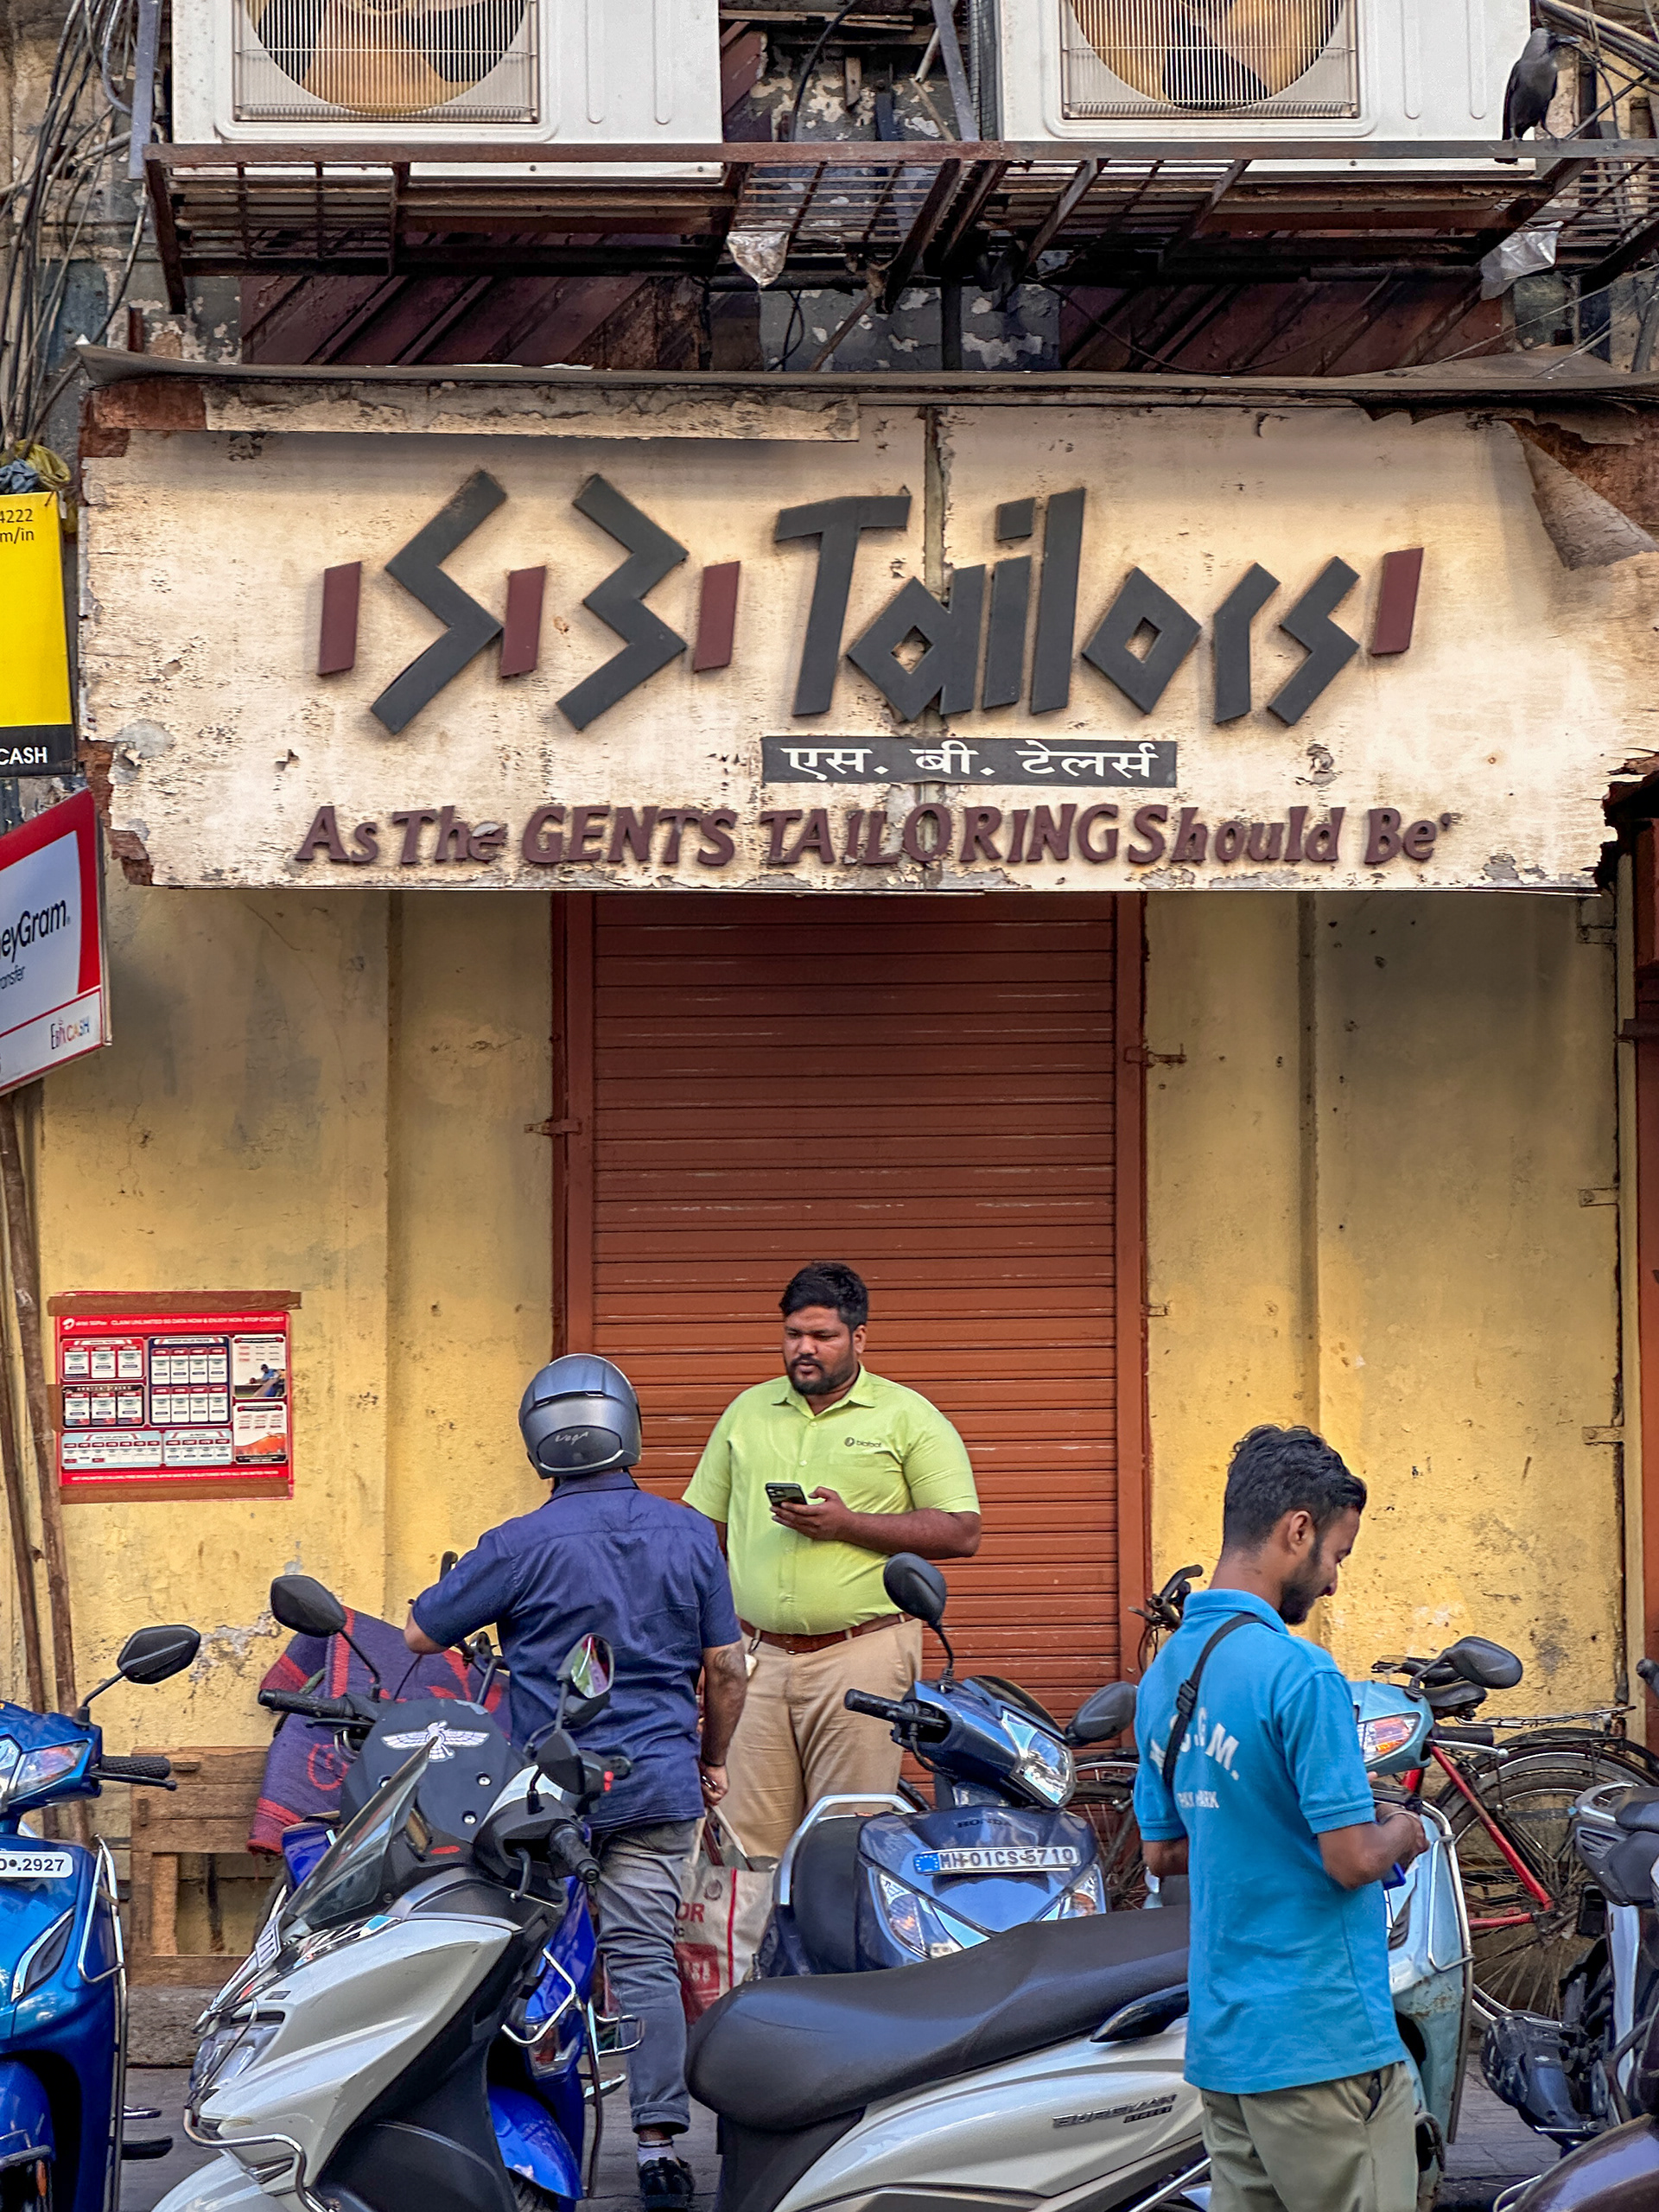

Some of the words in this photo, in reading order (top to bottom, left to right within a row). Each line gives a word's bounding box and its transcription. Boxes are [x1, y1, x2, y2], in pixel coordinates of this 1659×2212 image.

[0, 747, 48, 766] CASH
[780, 747, 890, 781] एस.
[910, 740, 995, 776] बी.
[1015, 739, 1159, 779] टेलर्स
[295, 805, 378, 863] As
[392, 804, 507, 863] The
[521, 804, 736, 864] GENTS
[759, 803, 1120, 865] TAILORING
[1128, 804, 1345, 863] Should
